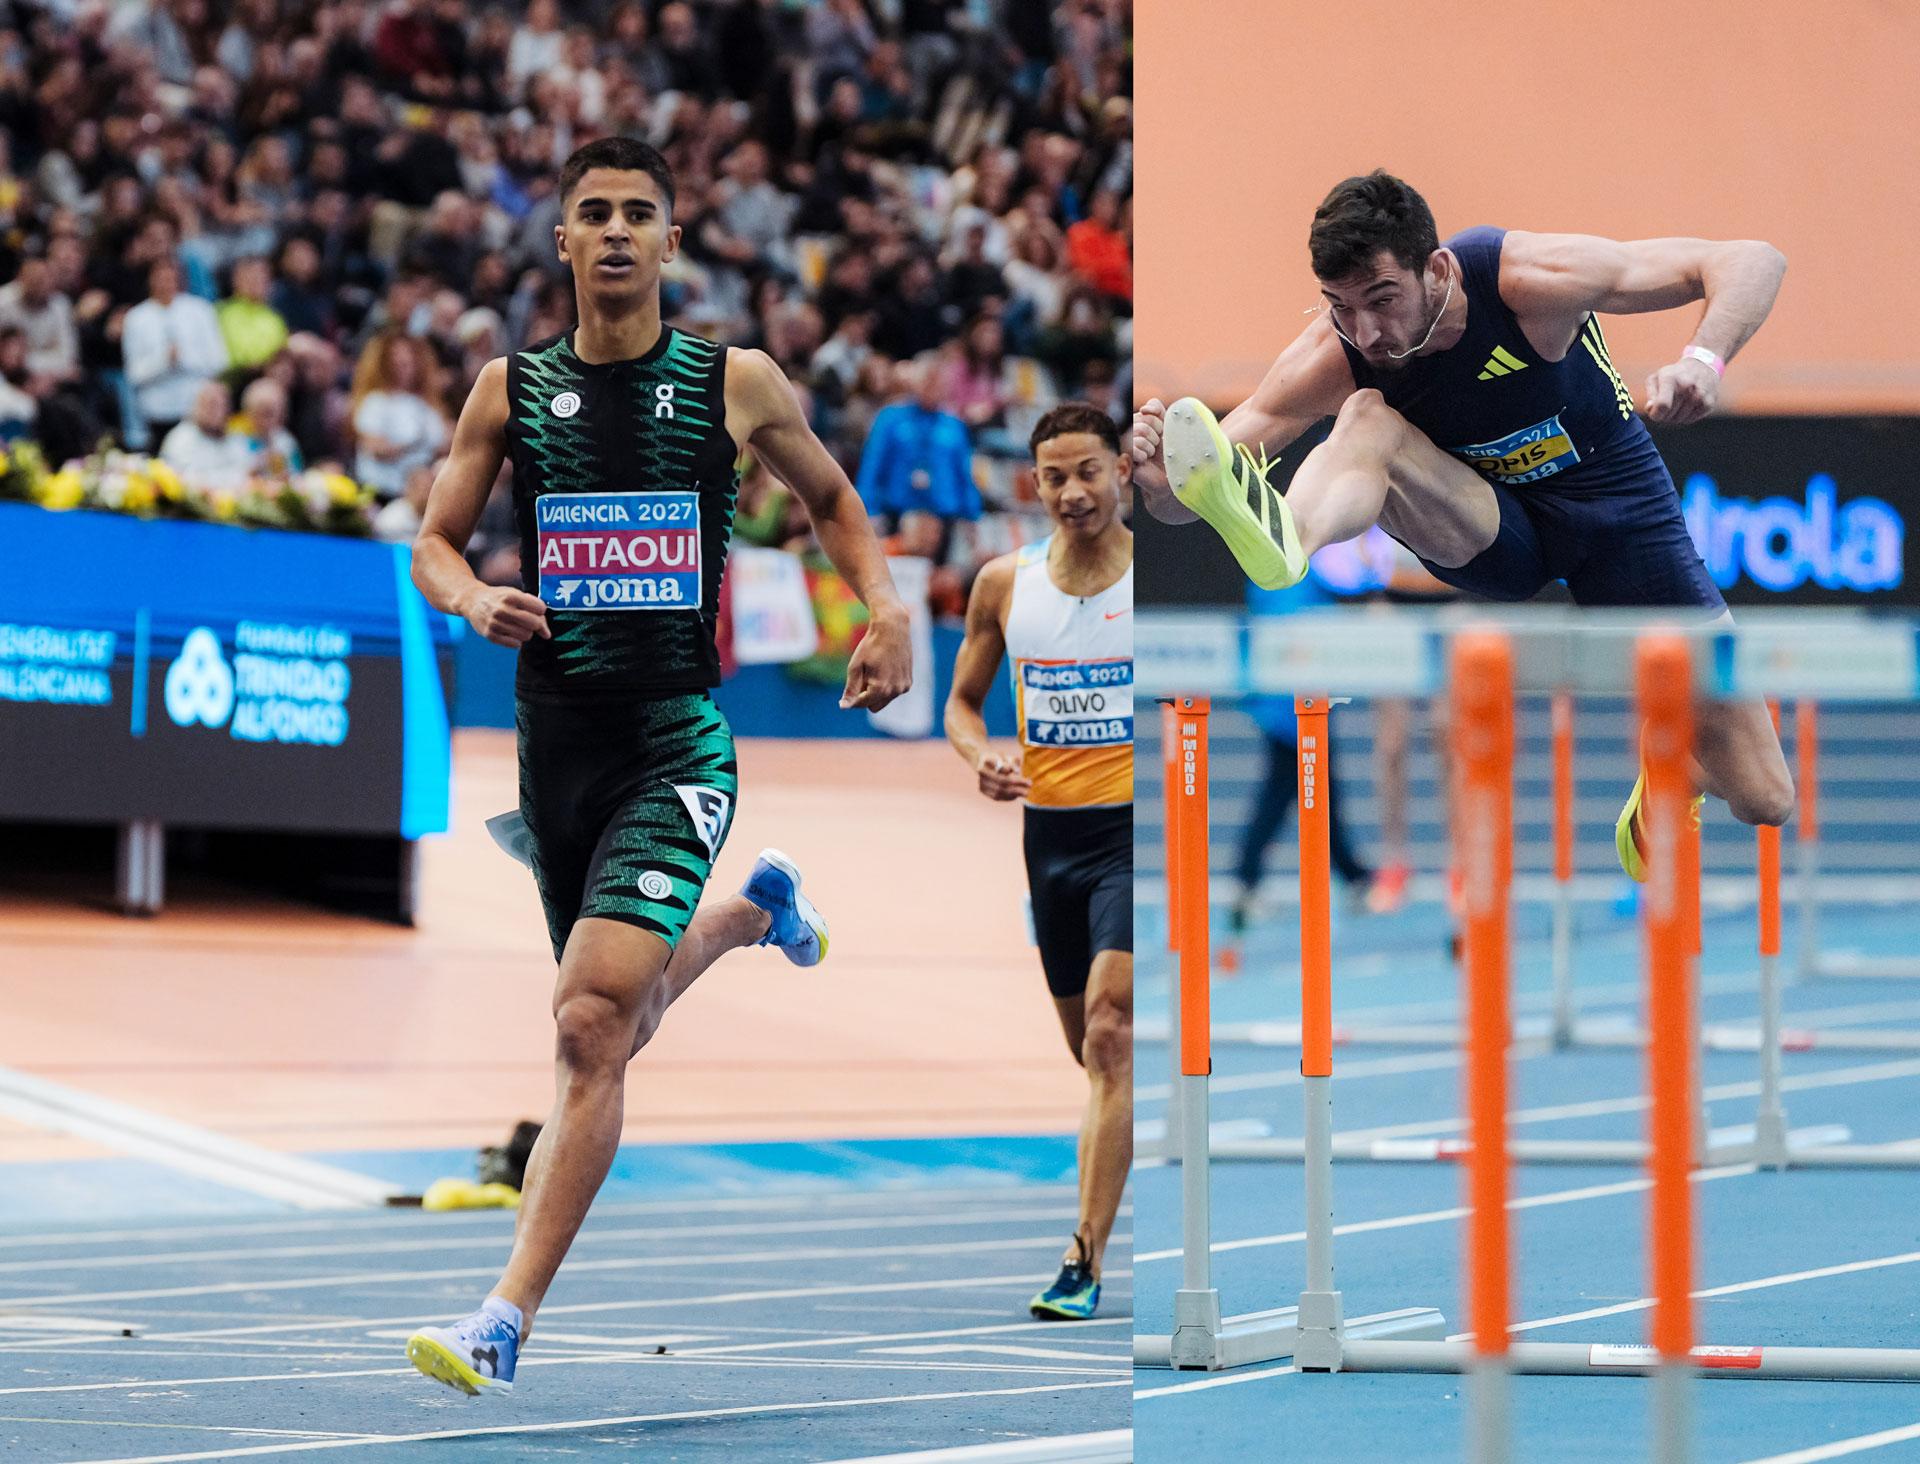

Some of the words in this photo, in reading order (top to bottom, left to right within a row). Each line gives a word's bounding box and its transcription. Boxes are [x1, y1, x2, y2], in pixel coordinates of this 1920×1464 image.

[1508, 423, 1552, 448] 27
[542, 504, 630, 523] VALENCIA
[638, 502, 693, 521] 2027
[540, 535, 697, 569] ATTAOUI
[1089, 665, 1129, 683] 2027
[1049, 693, 1106, 714] OLIVO
[1182, 739, 1197, 796] MONDO
[1302, 752, 1316, 809] MONDO
[695, 791, 723, 846] 5
